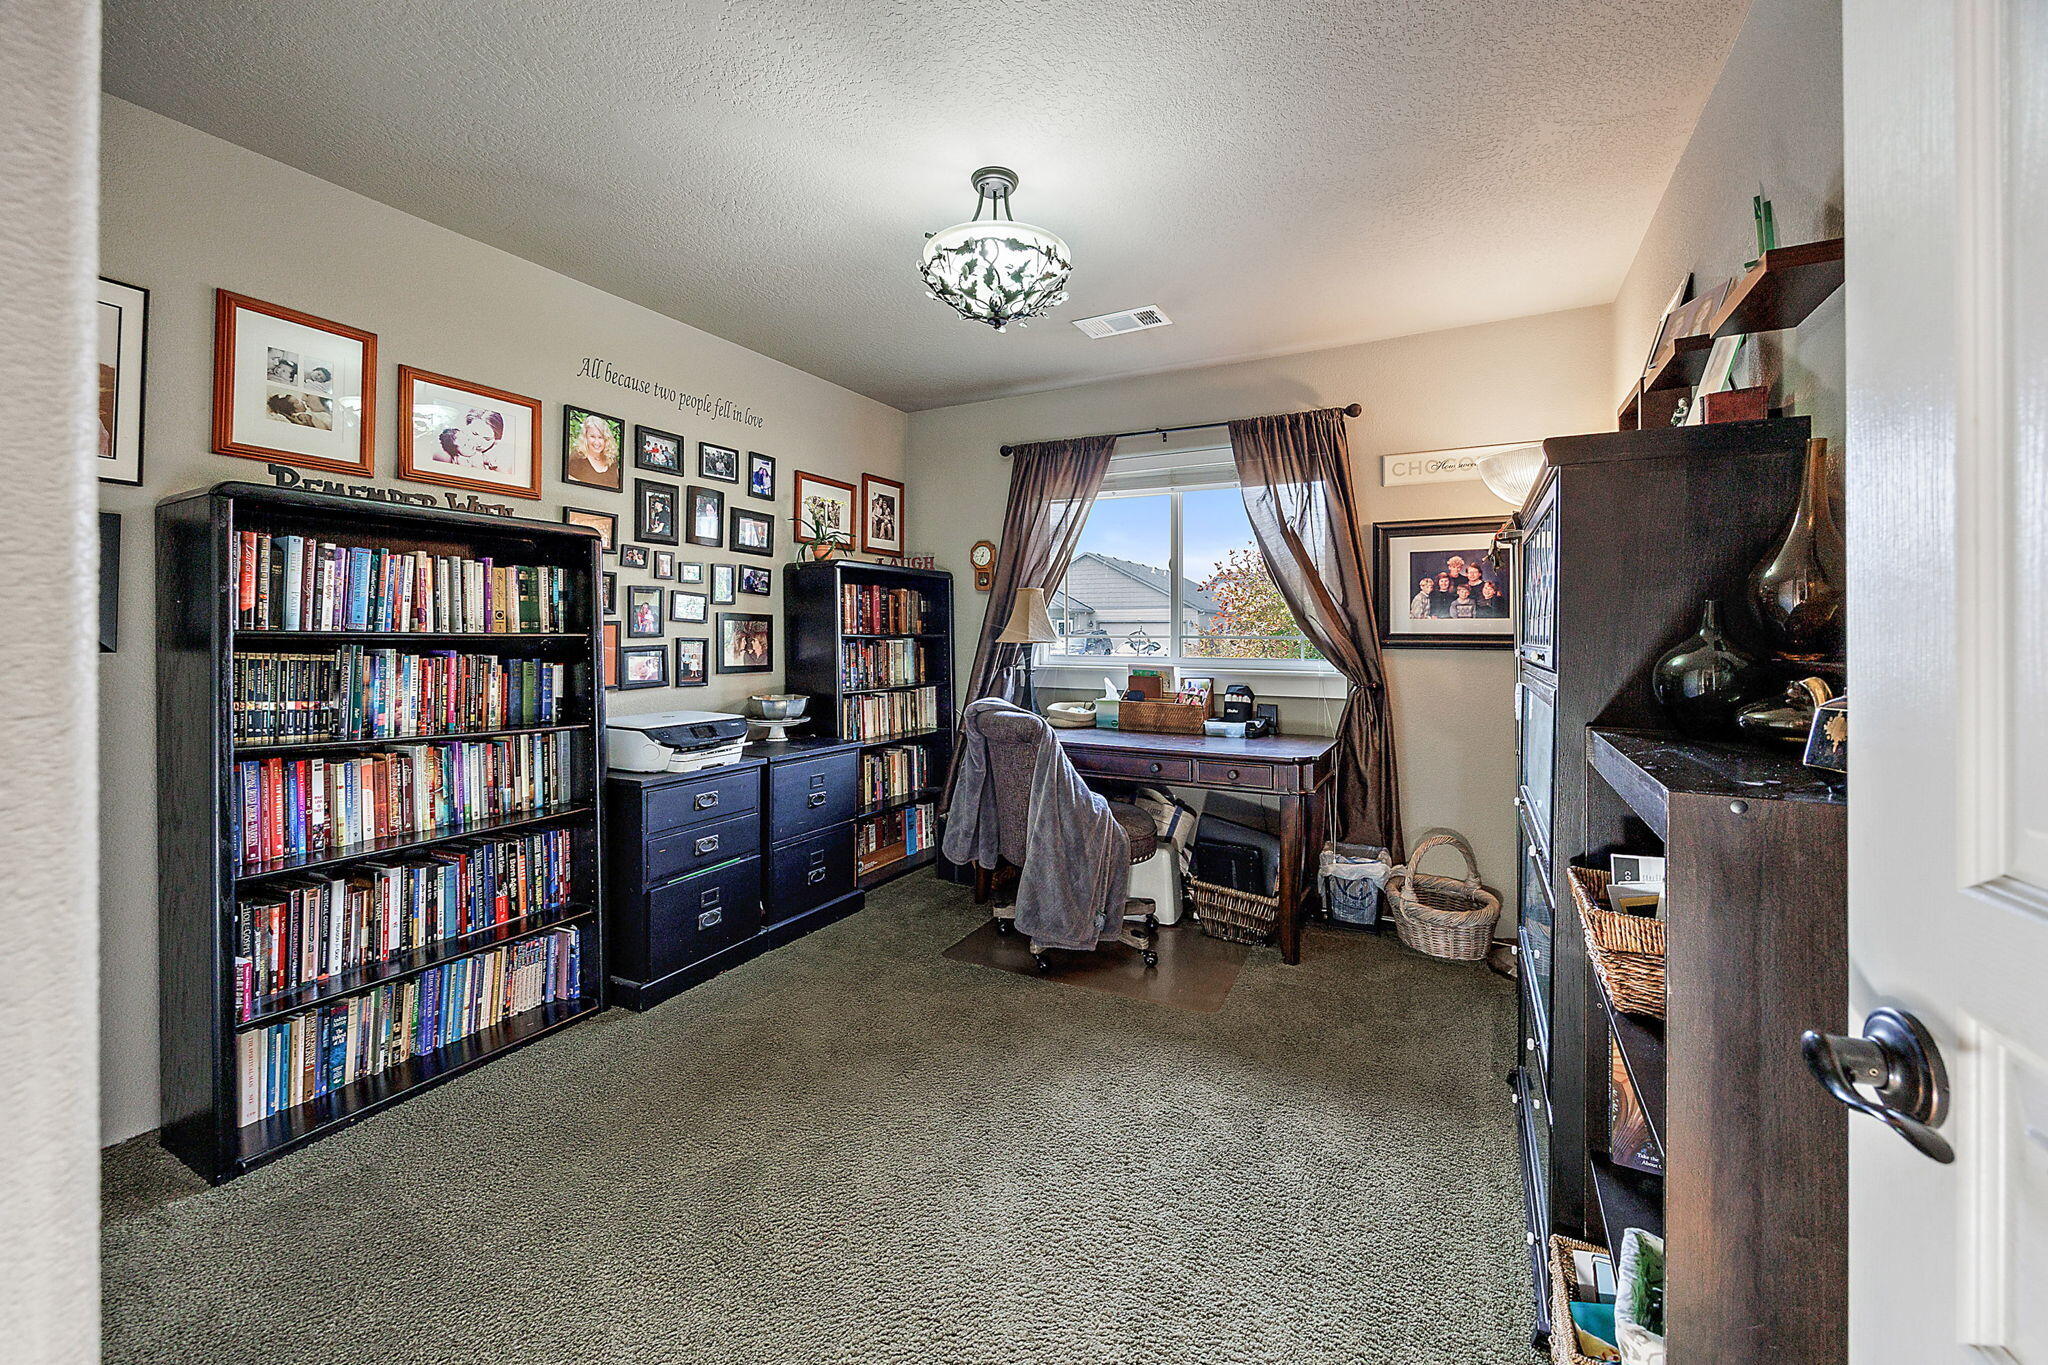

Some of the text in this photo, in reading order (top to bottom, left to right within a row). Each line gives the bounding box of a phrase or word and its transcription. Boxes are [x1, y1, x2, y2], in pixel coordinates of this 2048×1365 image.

[577, 358, 764, 428] All because two people fell in love
[1392, 456, 1479, 476] CHOCO
[1430, 459, 1456, 471] How
[340, 664, 350, 694] GRAHAM
[475, 875, 482, 886] Am
[508, 878, 517, 898] Again
[243, 908, 252, 926] HOLE
[243, 929, 251, 955] GOSPEL
[1642, 1160, 1658, 1168] About
